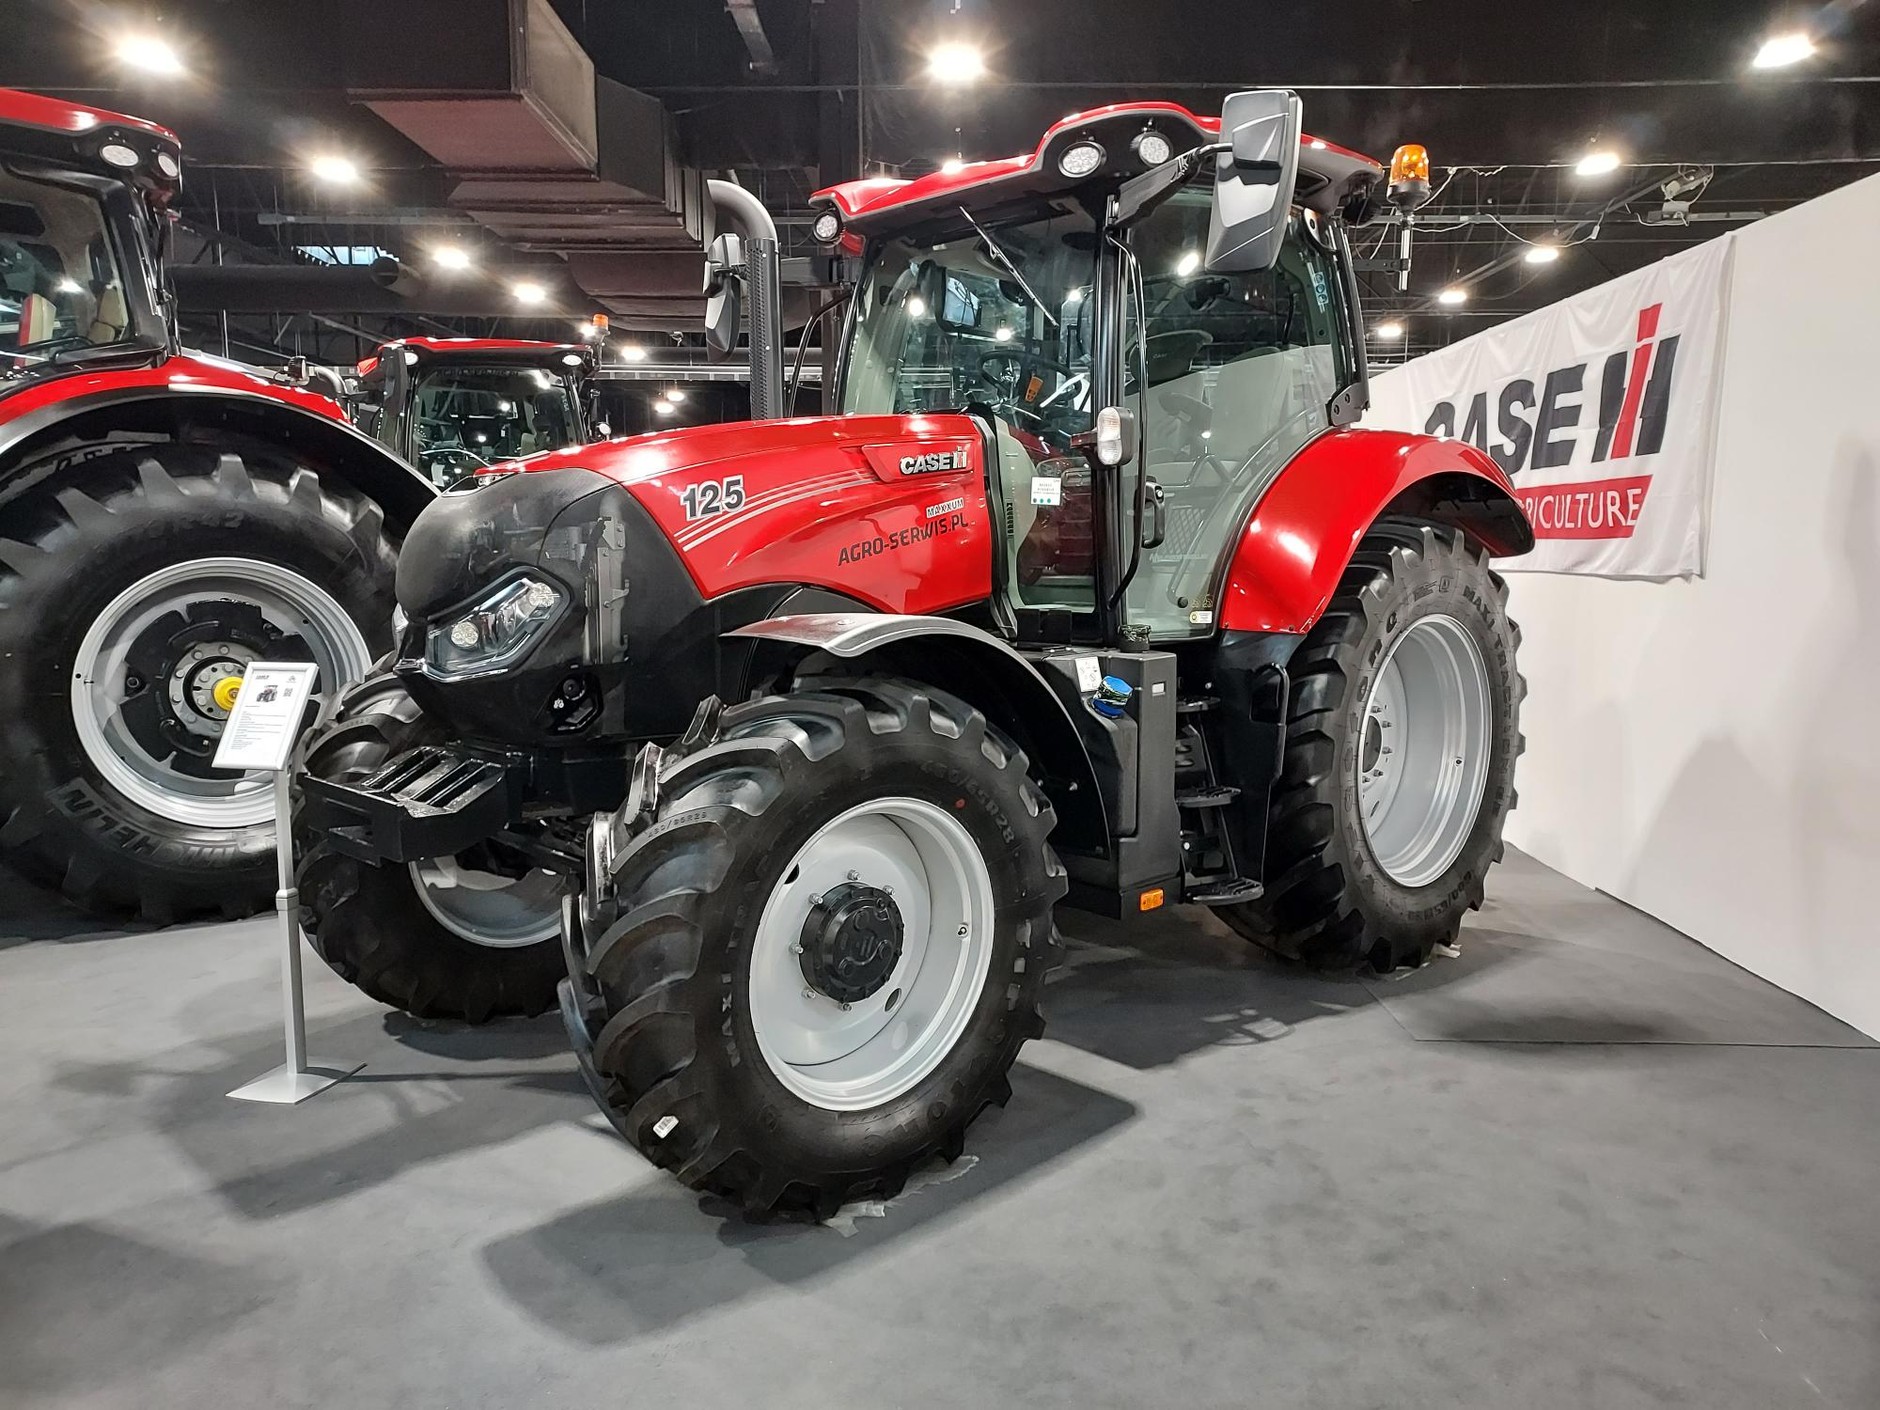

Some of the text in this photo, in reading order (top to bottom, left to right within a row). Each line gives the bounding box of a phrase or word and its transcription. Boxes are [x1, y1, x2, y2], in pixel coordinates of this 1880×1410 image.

[899, 452, 951, 475] CASE
[680, 475, 745, 521] 125
[926, 498, 964, 517] MAXXUM
[1515, 488, 1642, 529] RICULTURE
[838, 516, 969, 566] AGRO-SERWIS.PL
[720, 973, 741, 1068] MAXI
